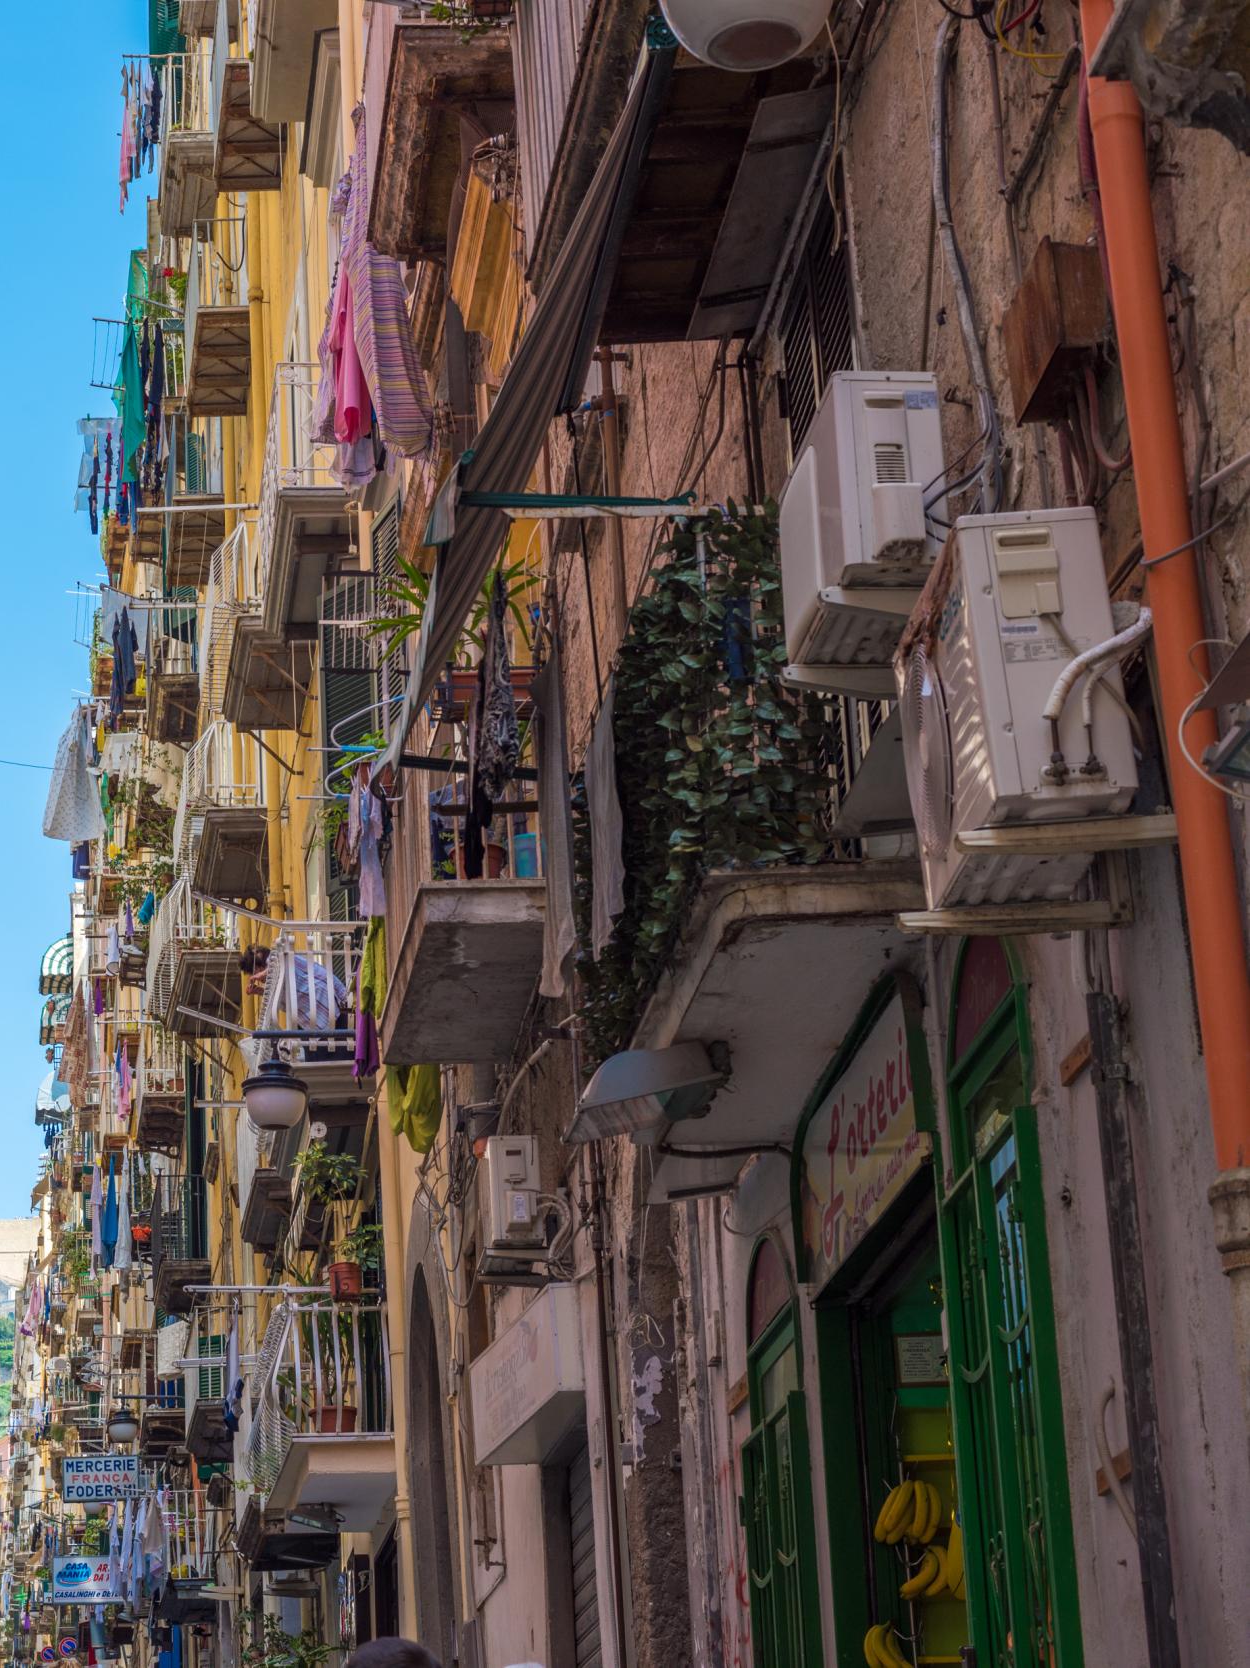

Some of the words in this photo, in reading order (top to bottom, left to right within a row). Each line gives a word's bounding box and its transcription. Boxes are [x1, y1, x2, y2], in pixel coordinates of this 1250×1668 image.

[65, 1459, 136, 1473] MERCERIE
[71, 1472, 130, 1484] FRANCA
[66, 1484, 137, 1498] FODERAMI
[65, 1562, 88, 1570] CASA
[56, 1570, 90, 1579] MANIA
